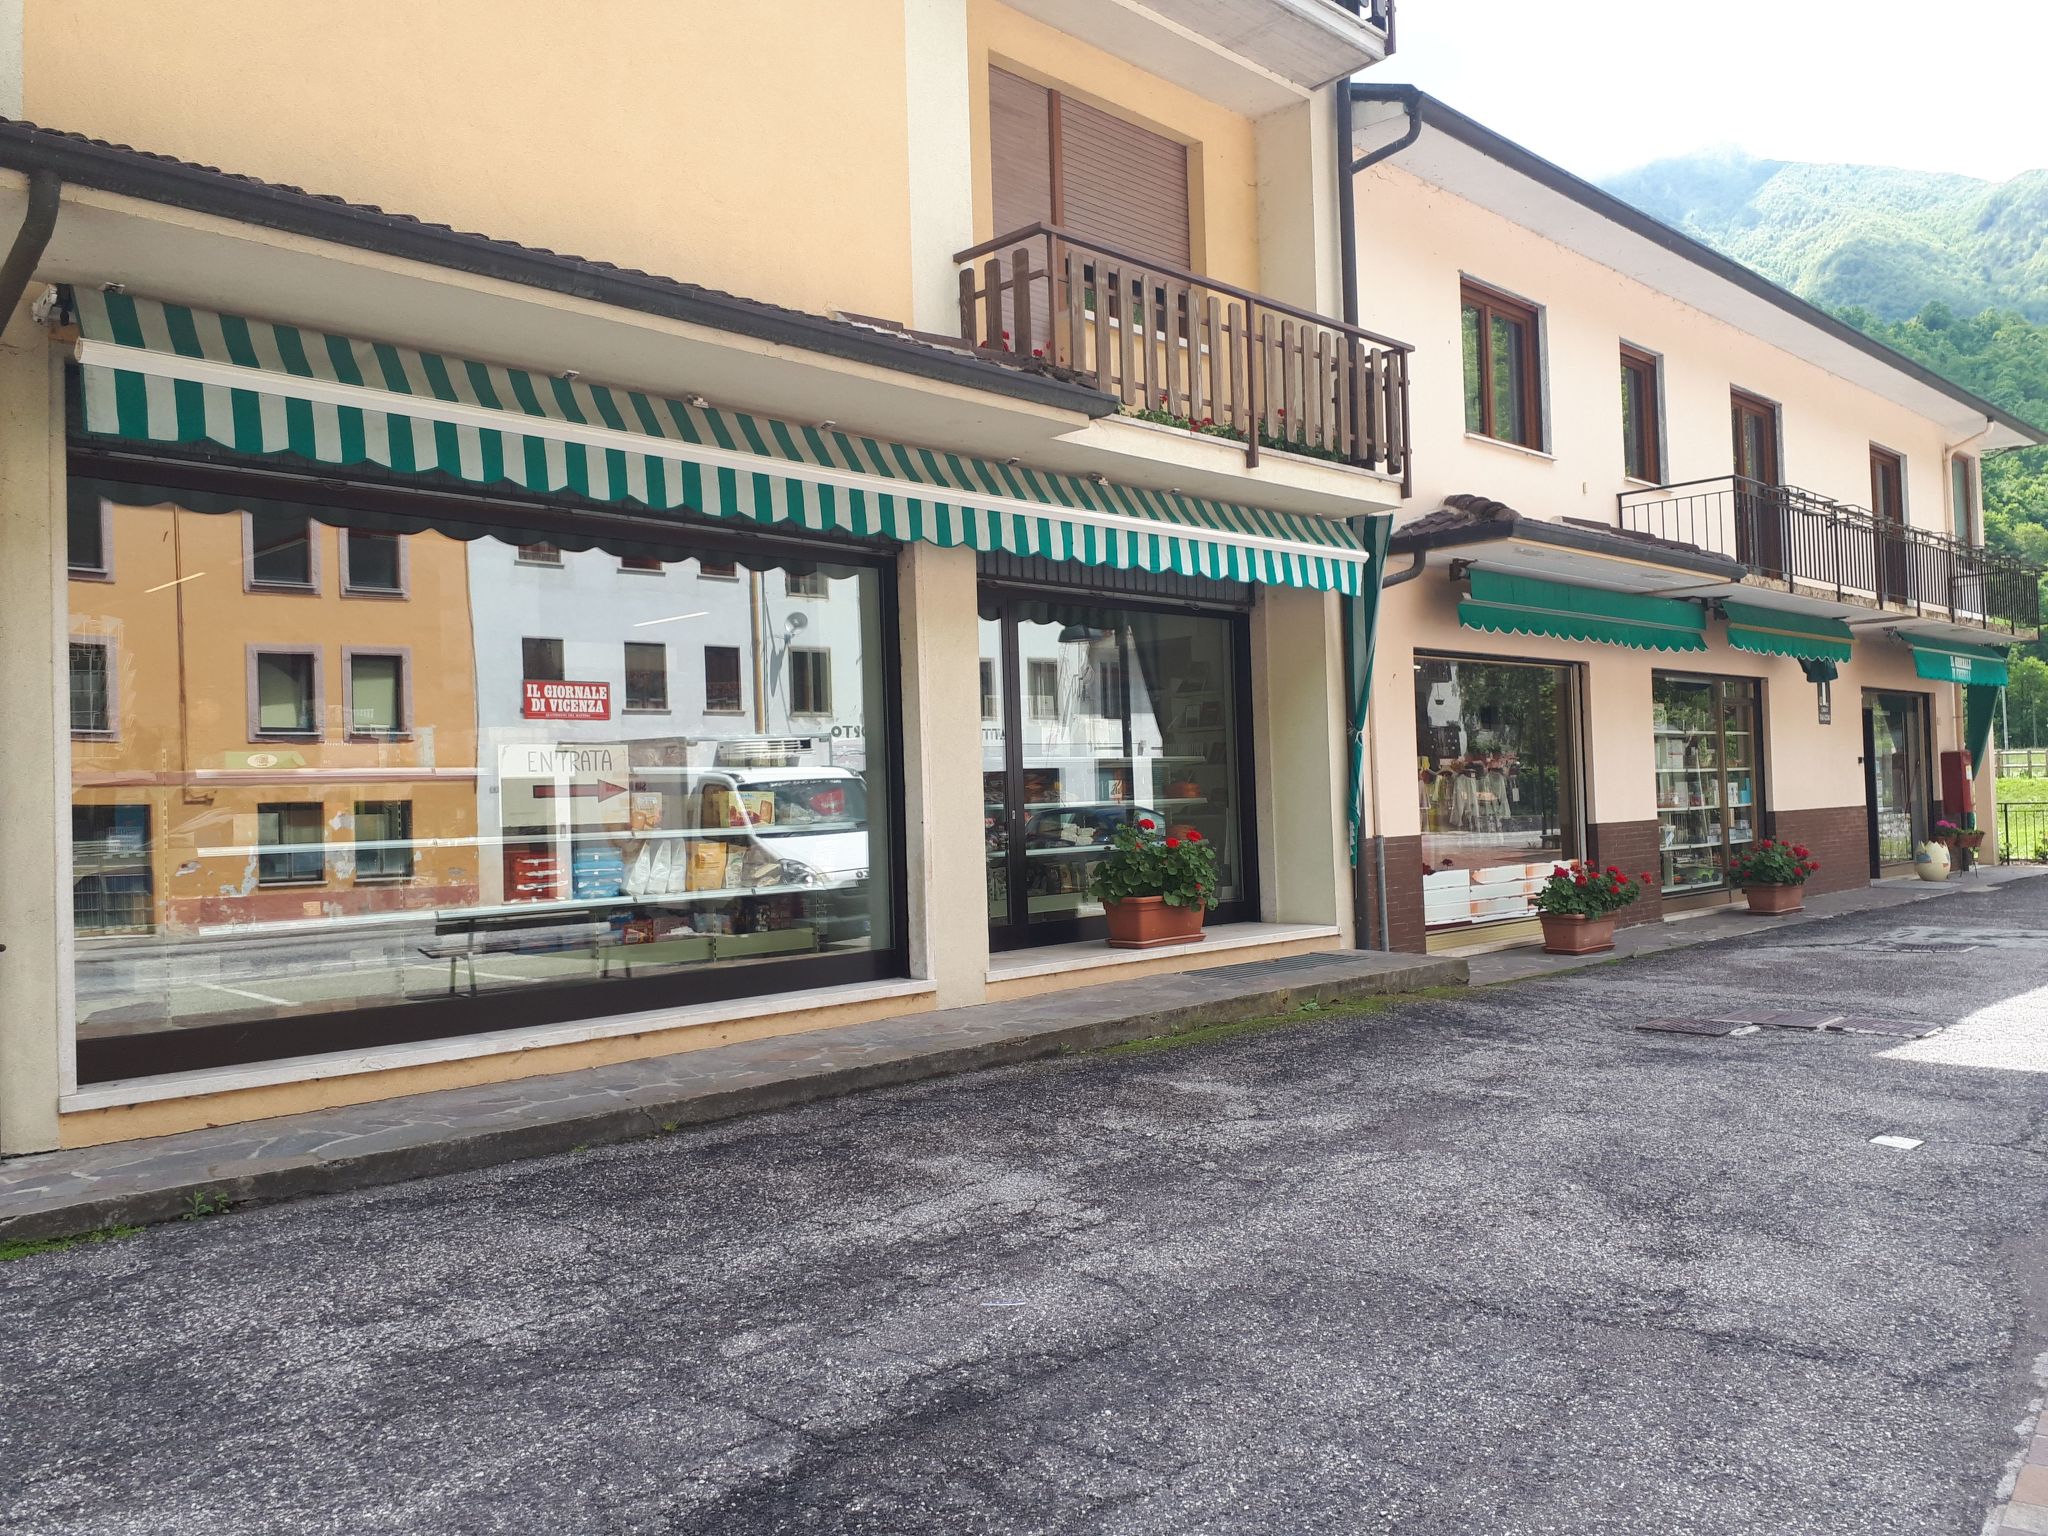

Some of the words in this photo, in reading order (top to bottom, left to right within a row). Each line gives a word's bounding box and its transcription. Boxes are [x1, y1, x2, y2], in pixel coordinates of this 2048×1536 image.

[526, 684, 540, 697] IL
[543, 685, 607, 699] GIORNALE
[531, 698, 546, 712] DI
[549, 699, 604, 713] VICENZA
[528, 749, 613, 772] ENTRATA
